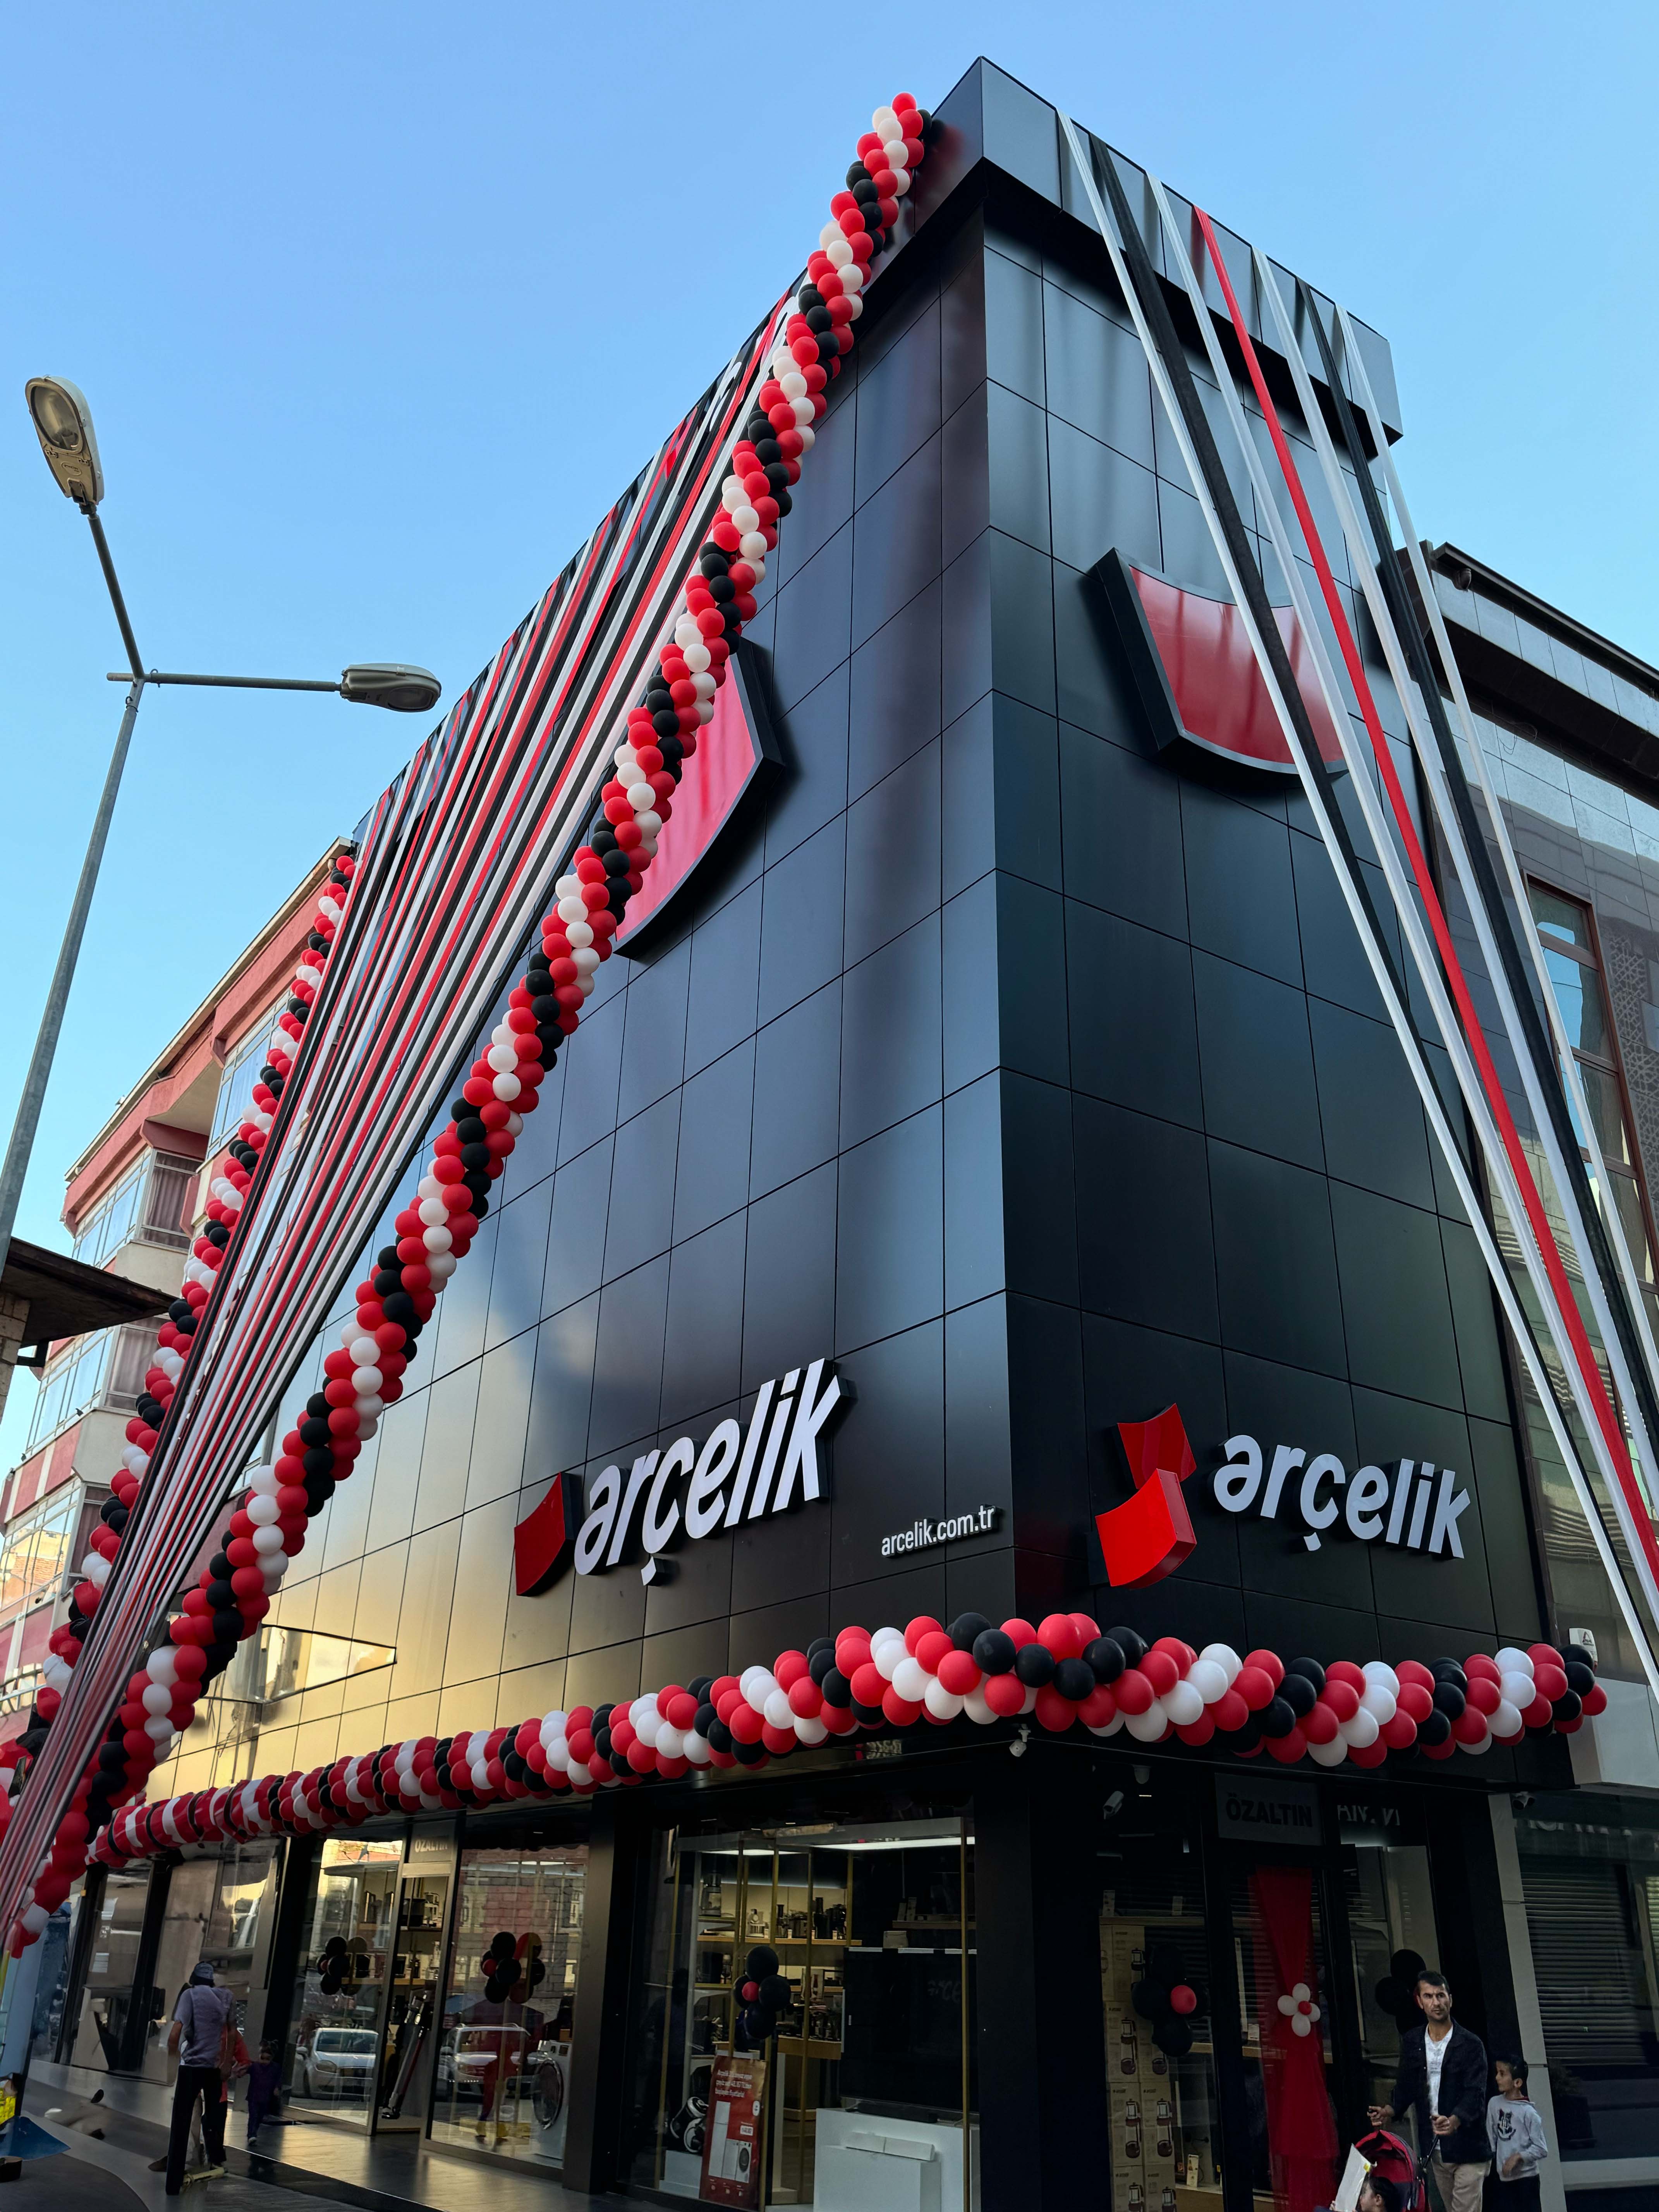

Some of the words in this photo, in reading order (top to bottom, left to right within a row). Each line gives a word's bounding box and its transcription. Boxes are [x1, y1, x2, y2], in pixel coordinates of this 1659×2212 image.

[574, 1358, 841, 1586] arçelik
[1213, 1434, 1471, 1559] arçelik
[881, 1505, 996, 1556] arcelik.com.tr
[1225, 1792, 1313, 1827] ÖZALTIN
